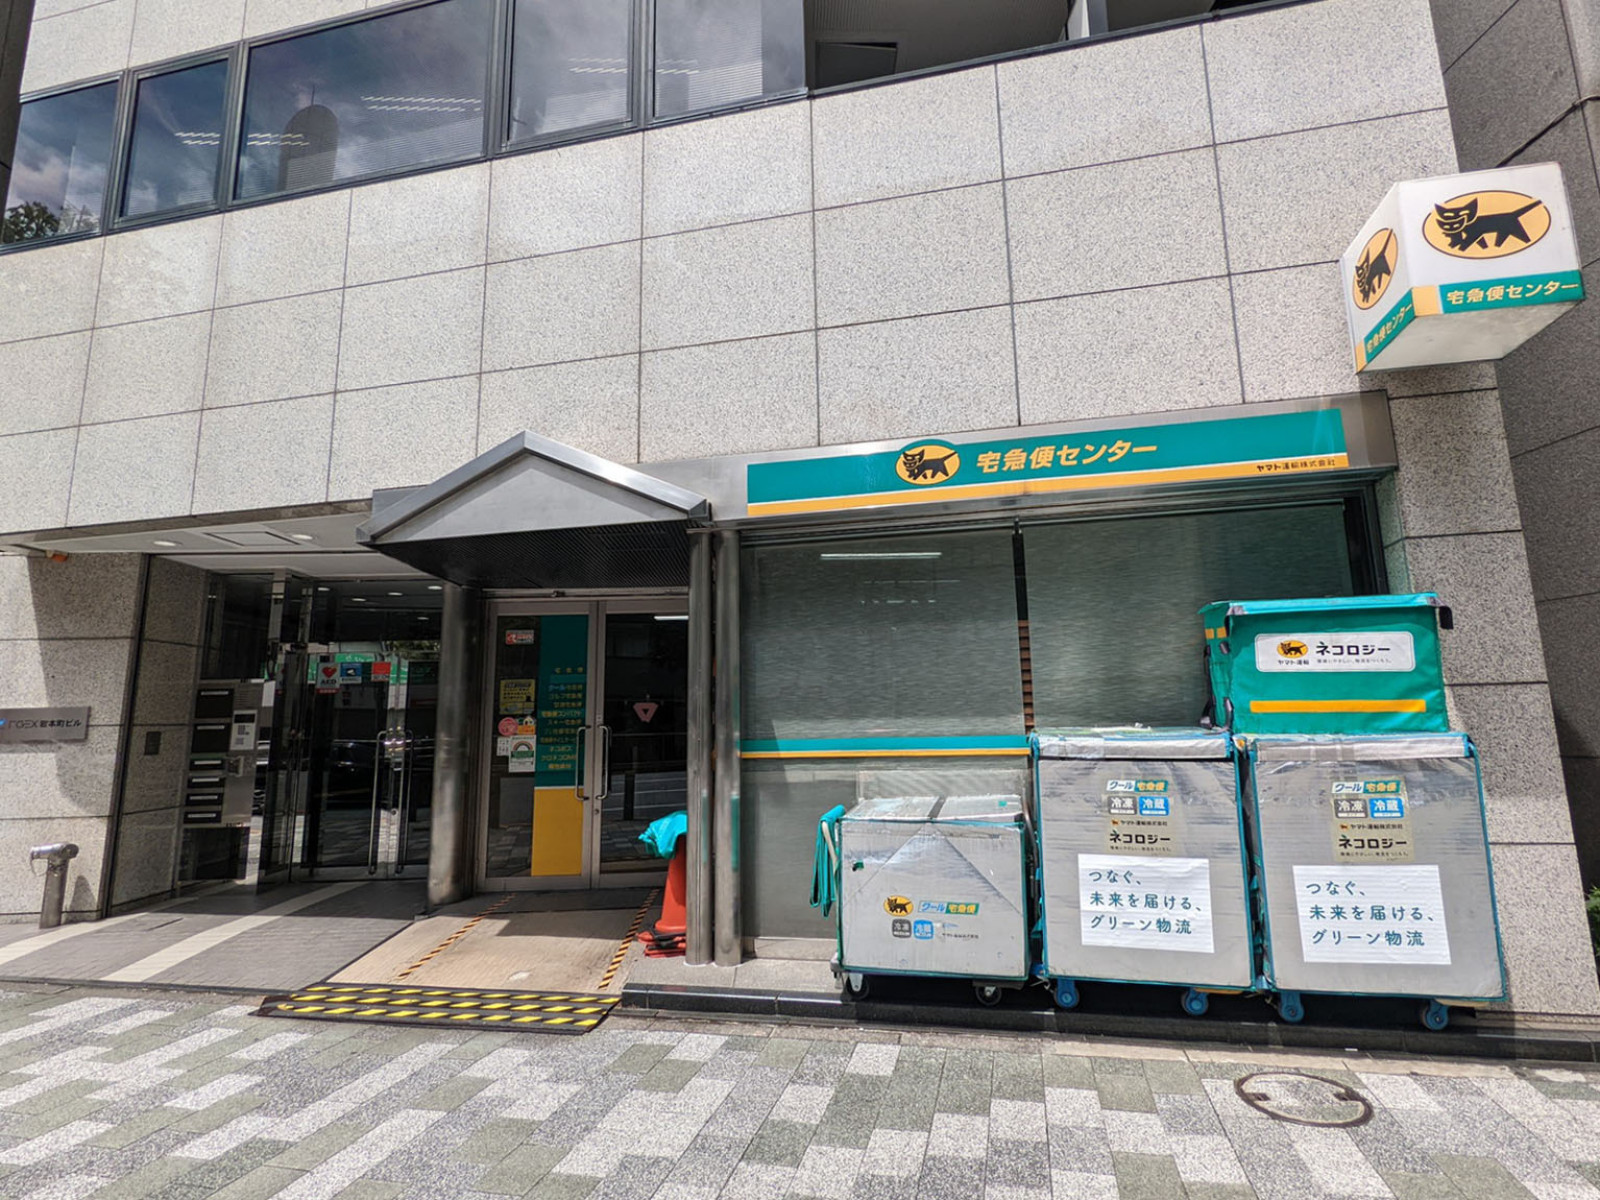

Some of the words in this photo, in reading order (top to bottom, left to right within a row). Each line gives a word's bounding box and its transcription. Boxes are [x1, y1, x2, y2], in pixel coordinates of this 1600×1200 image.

[1446, 281, 1579, 306] 宅急便センター
[1366, 303, 1413, 354] 宅急便センター
[976, 438, 1157, 475] 宅急便センター
[1256, 458, 1335, 472] ヤマト運輸株式会社
[1315, 641, 1391, 656] ネコロジー
[1111, 797, 1133, 809] 冷凍
[1142, 797, 1165, 809] 冷蔵
[1338, 800, 1363, 812] 冷凍
[1374, 800, 1399, 812] 冷蔵
[1109, 829, 1171, 844] ネコロジー
[1338, 834, 1407, 849] ネコロジー
[1089, 868, 1142, 885] つなぐ、
[1306, 880, 1366, 897] つなぐ、
[1090, 892, 1202, 912] 未来を届ける、
[1309, 903, 1435, 923] 未来を届ける、
[1090, 914, 1193, 935] グリーン物流
[1312, 928, 1425, 948] グリーン物流
